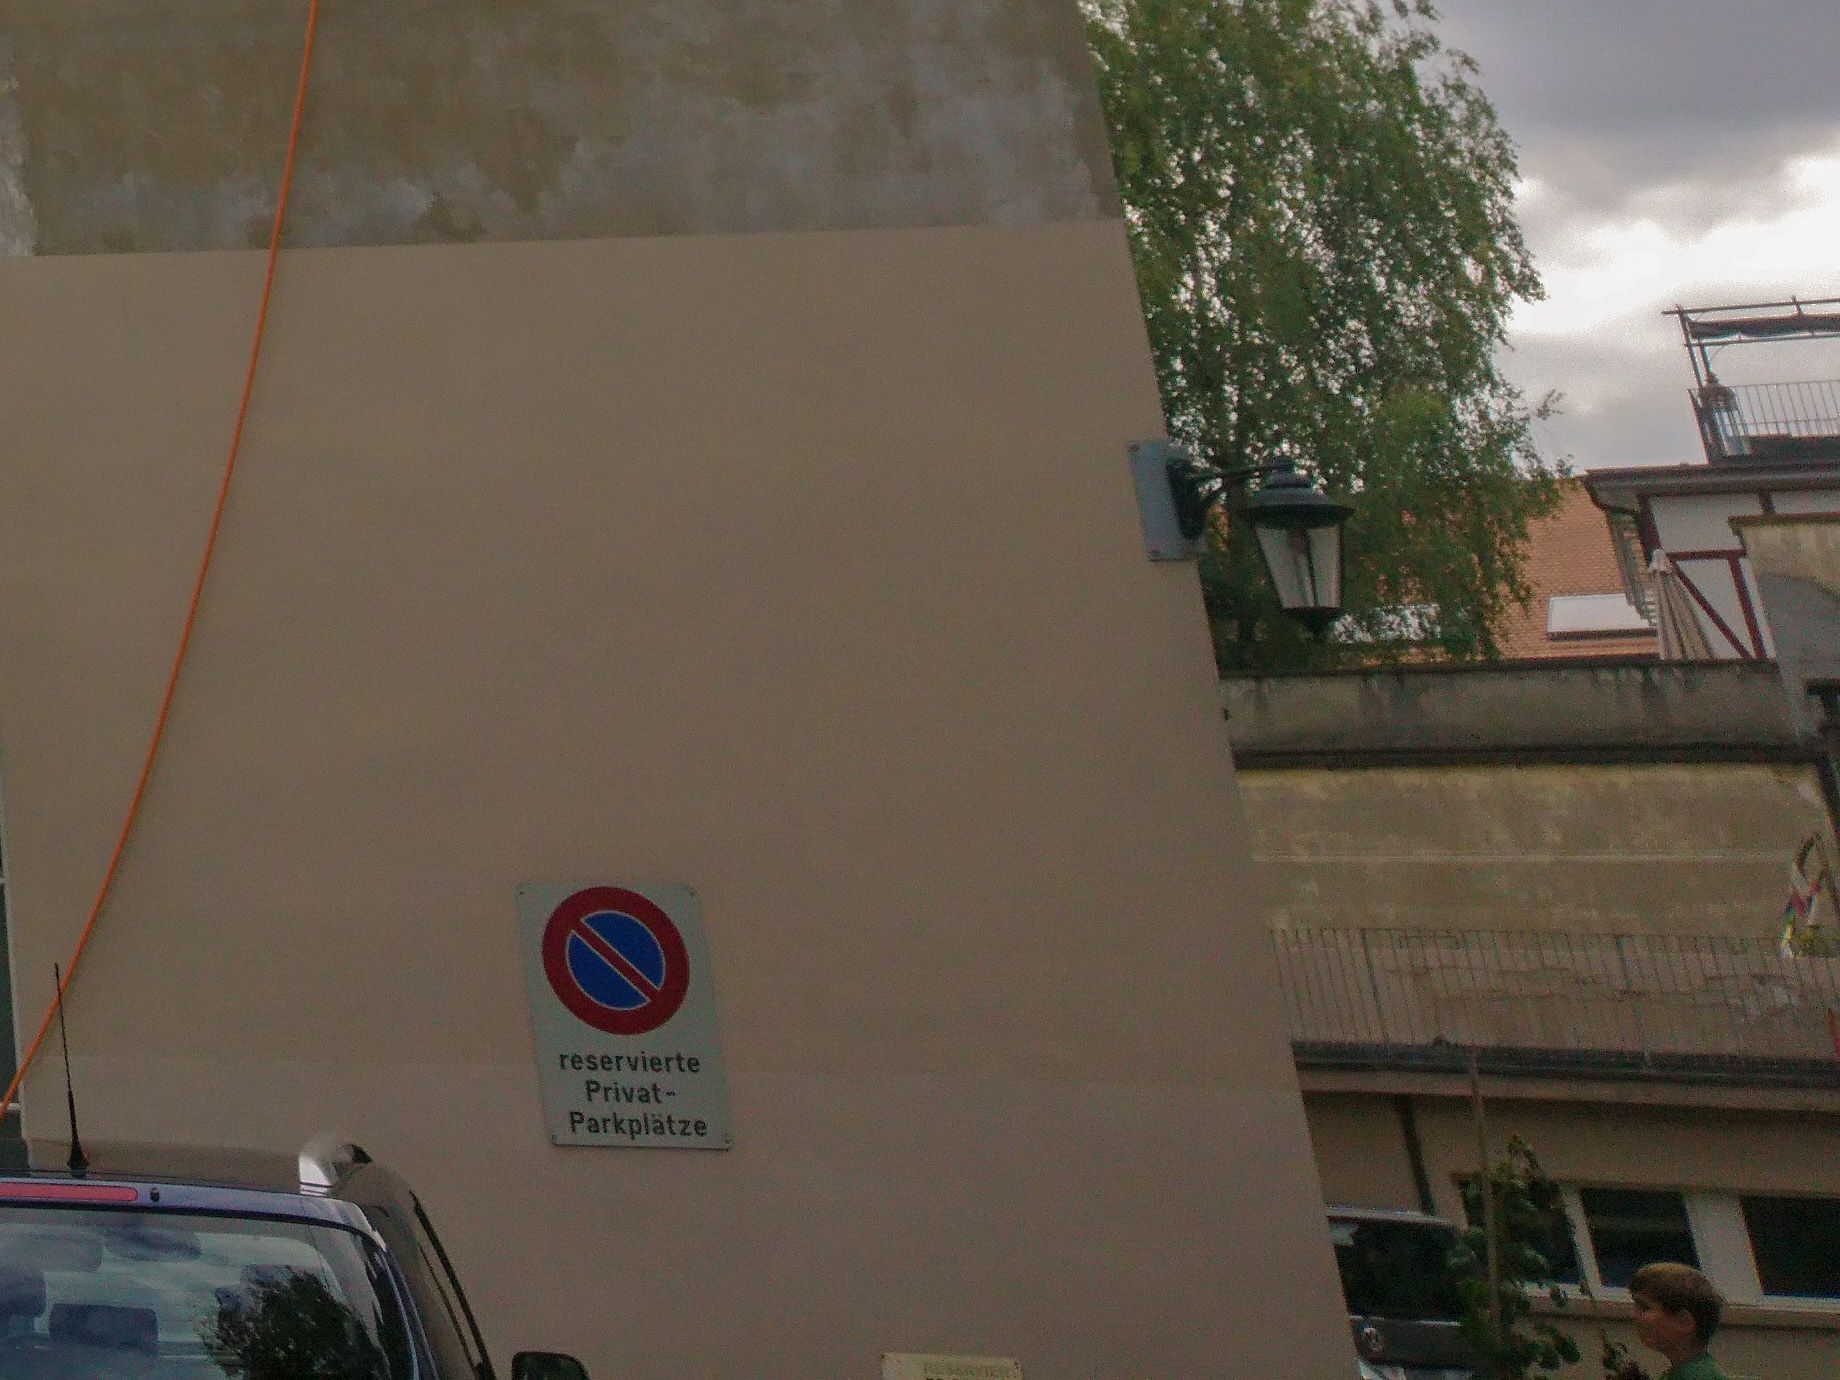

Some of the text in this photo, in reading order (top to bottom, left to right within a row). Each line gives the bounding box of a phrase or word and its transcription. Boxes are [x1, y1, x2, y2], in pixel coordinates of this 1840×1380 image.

[558, 1050, 702, 1074] reservierte
[584, 1078, 677, 1104] Privat-
[569, 1110, 708, 1141] Parkplätze
